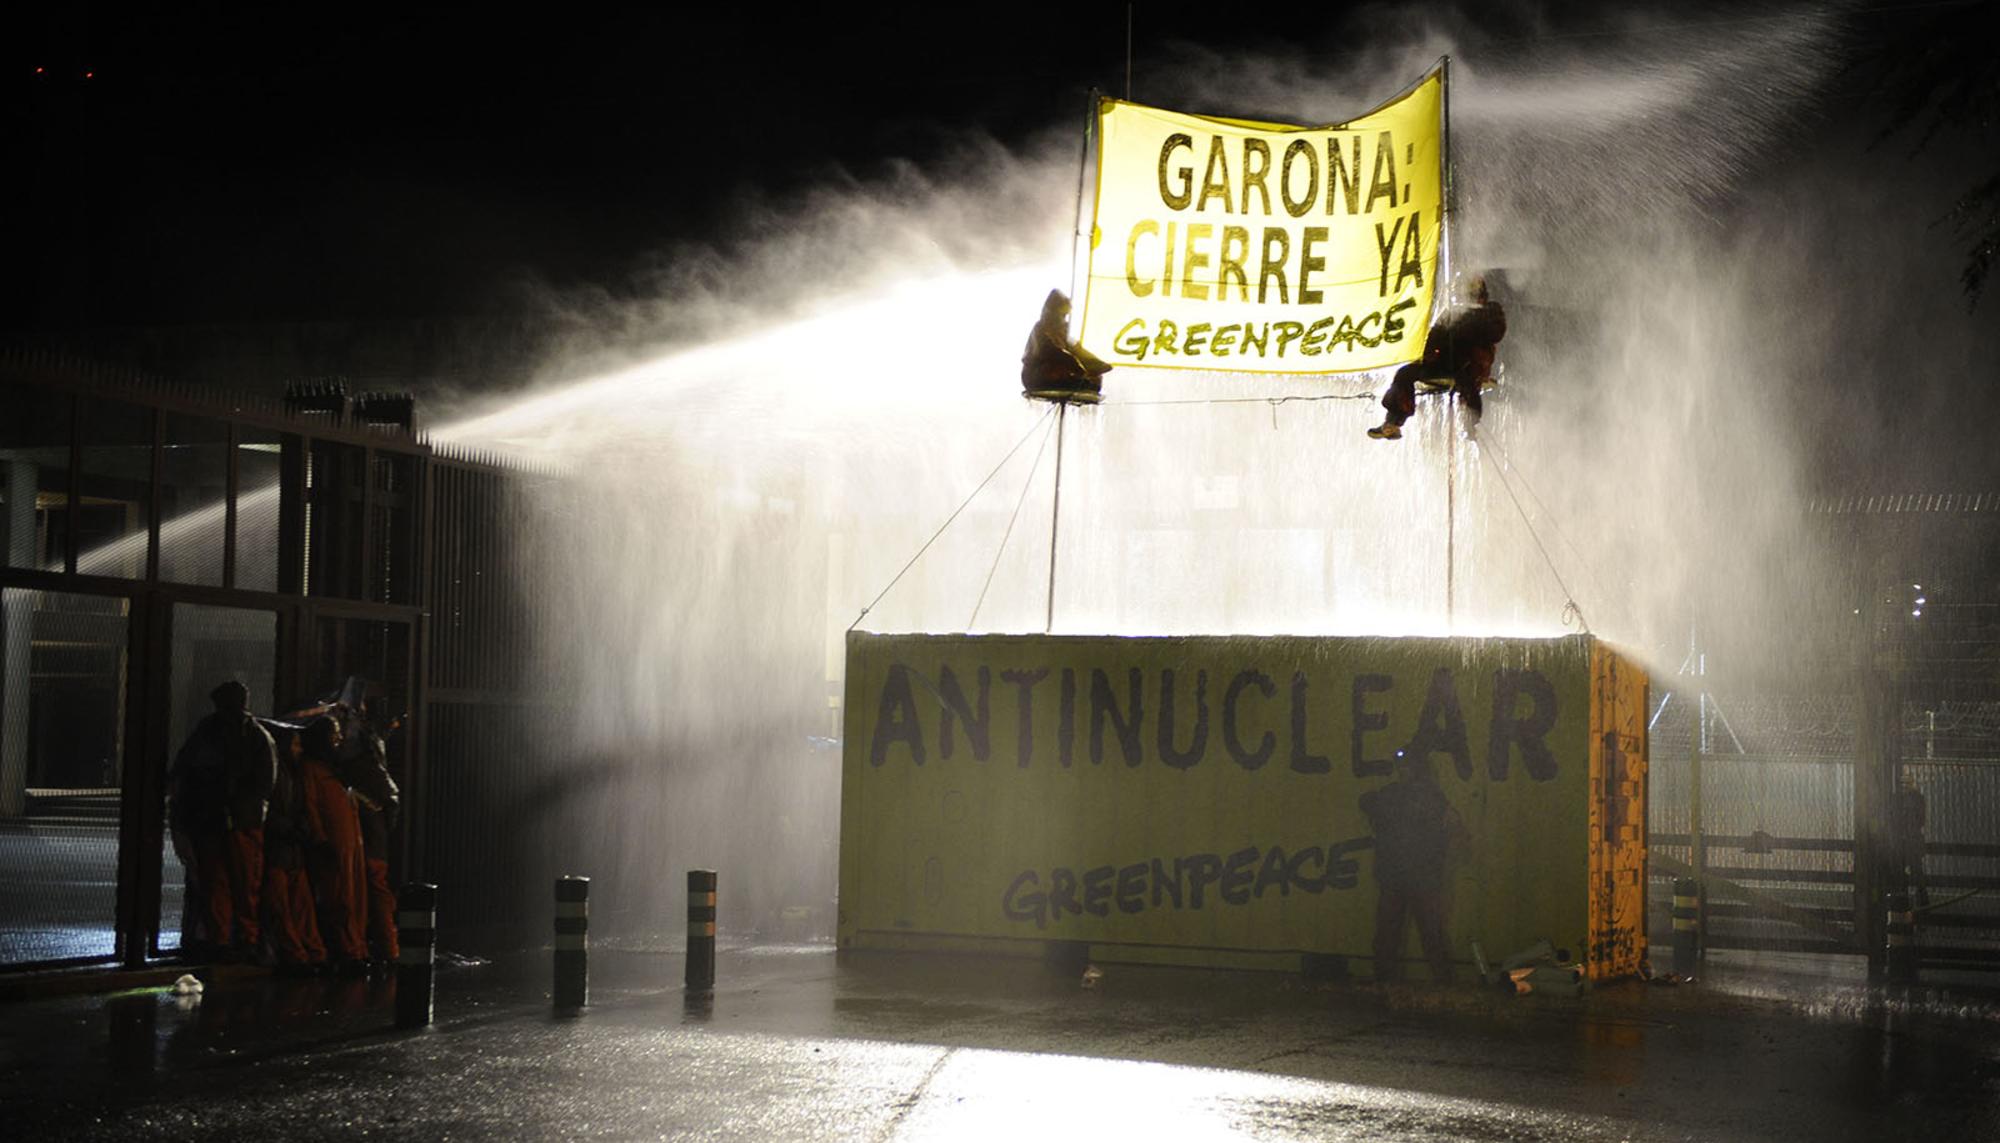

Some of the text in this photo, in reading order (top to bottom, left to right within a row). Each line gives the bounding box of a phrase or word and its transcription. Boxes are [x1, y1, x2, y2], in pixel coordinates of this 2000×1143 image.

[1126, 212, 1424, 305] CIERRE YA
[1113, 299, 1416, 361] GREENPEACE
[870, 664, 1558, 781] ANTINUCLEAR
[1002, 836, 1373, 930] GREENPEACE
